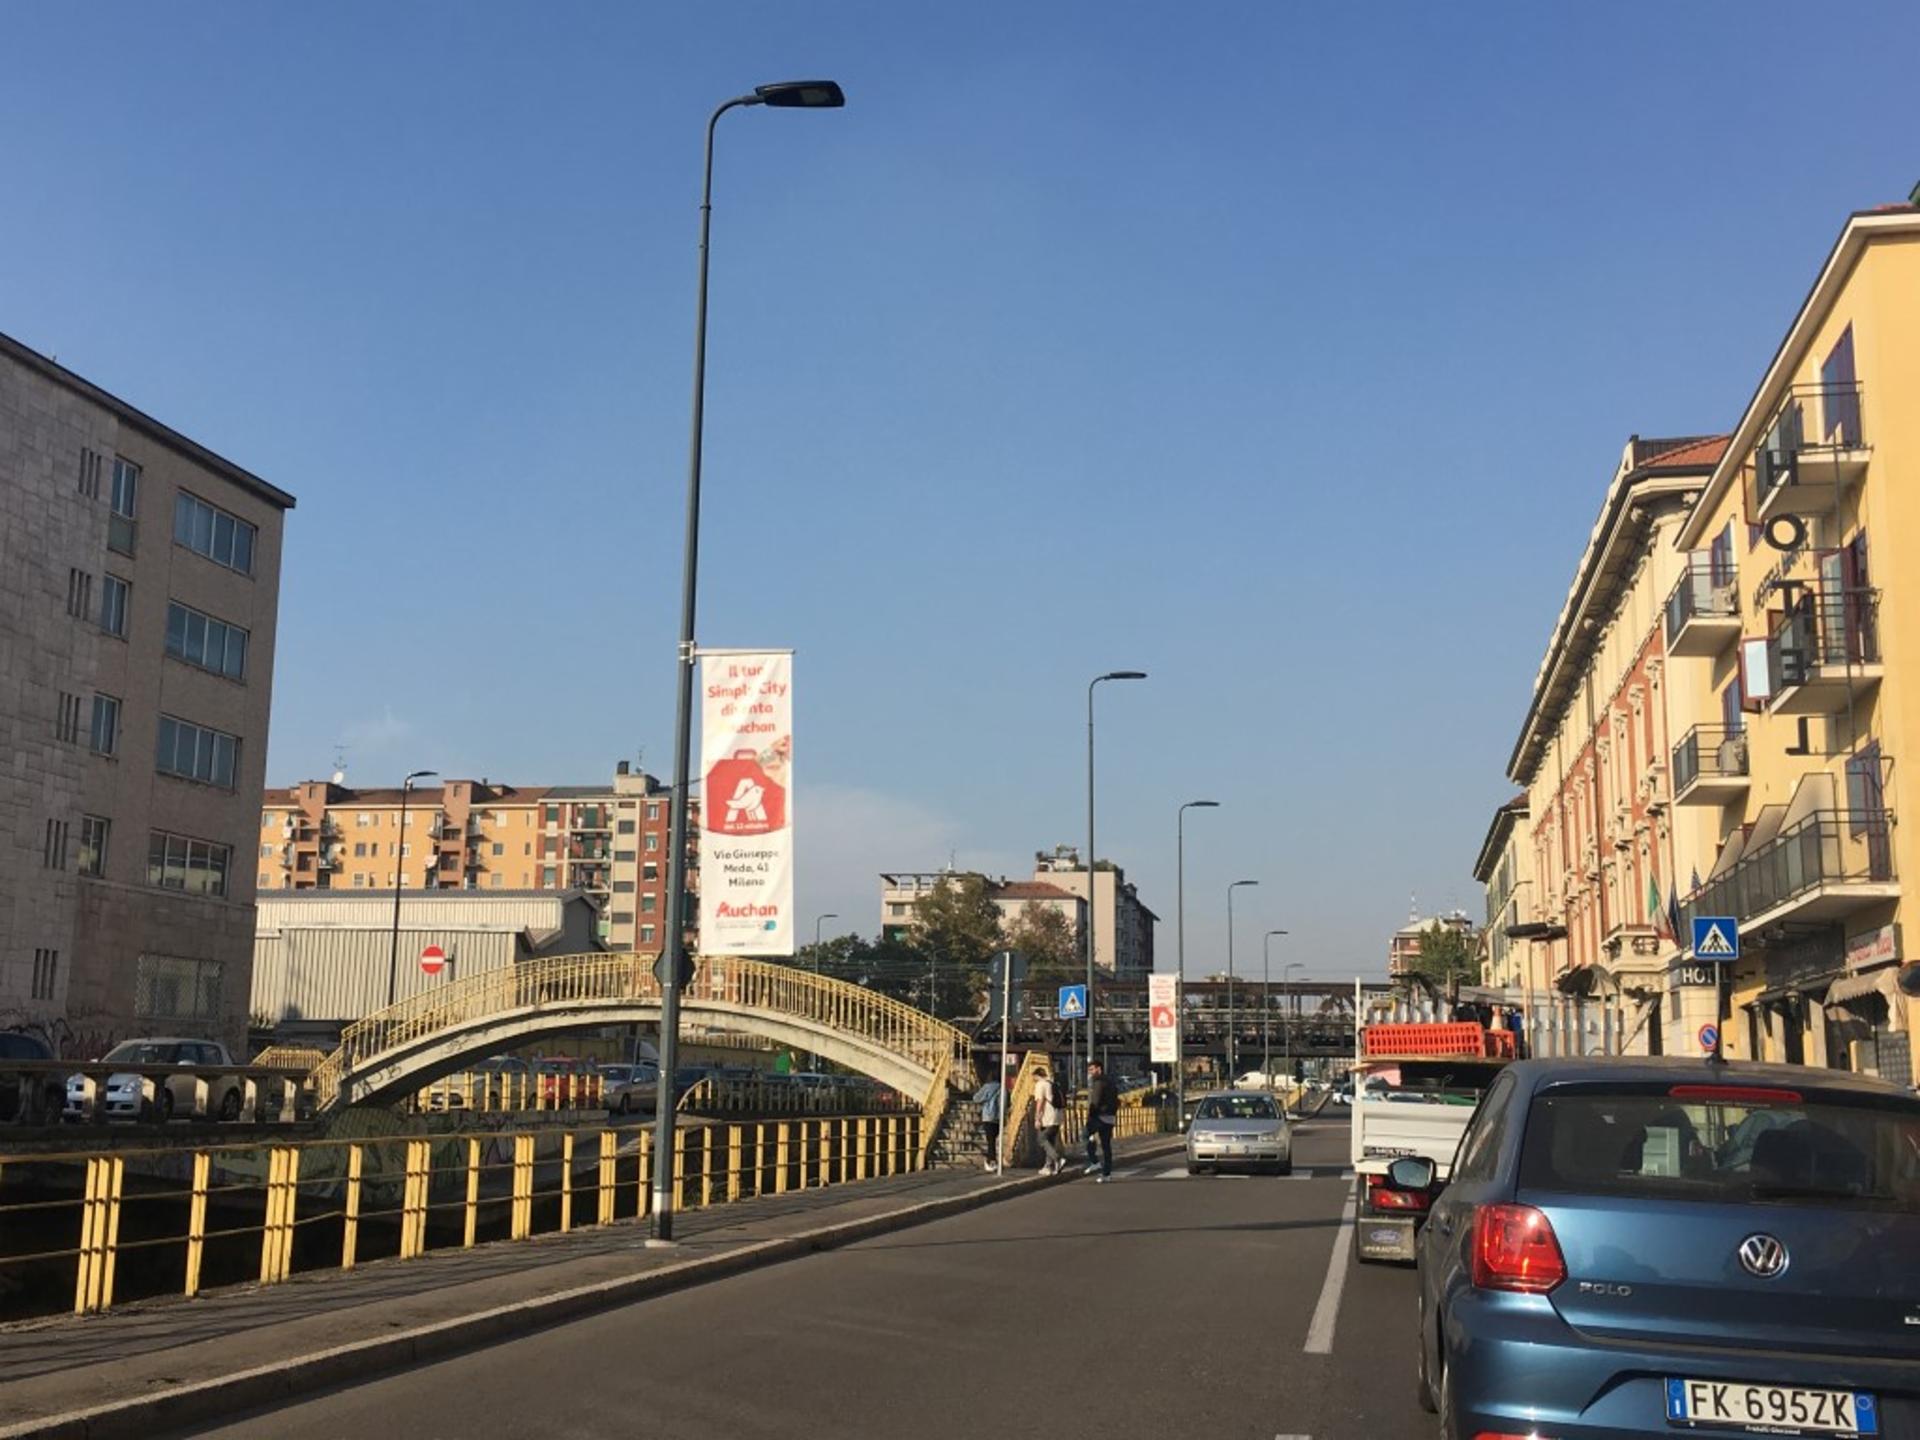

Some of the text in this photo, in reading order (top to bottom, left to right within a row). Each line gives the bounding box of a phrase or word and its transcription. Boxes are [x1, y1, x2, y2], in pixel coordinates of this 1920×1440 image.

[729, 877, 765, 887] Milano
[716, 901, 778, 918] Auchan
[1683, 967, 1730, 984] HOTL
[1580, 1281, 1632, 1296] POLO
[1691, 1383, 1731, 1418] FK
[1744, 1387, 1853, 1428] 695ZK
